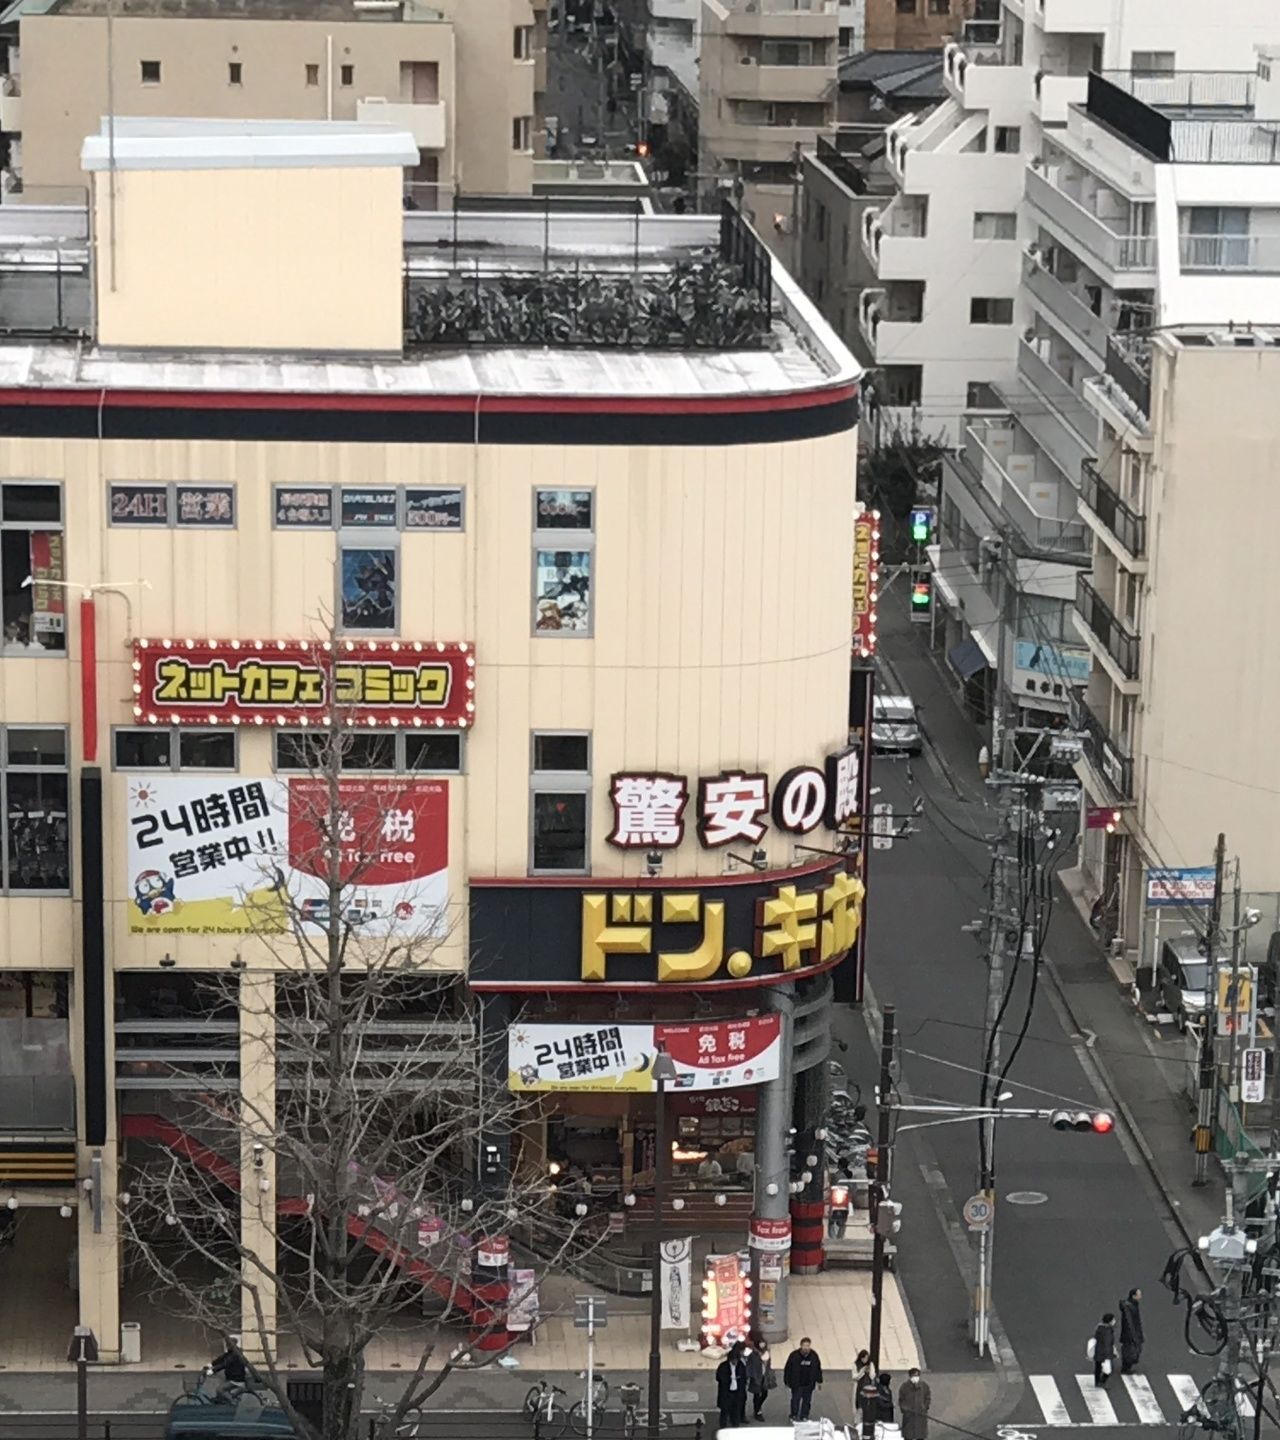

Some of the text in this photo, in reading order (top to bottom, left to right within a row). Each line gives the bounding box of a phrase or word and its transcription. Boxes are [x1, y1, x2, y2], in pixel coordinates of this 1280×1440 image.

[112, 493, 167, 517] 24H
[158, 663, 446, 702] ネットカフェ コミック
[131, 782, 270, 849] 24時間
[613, 750, 860, 845] 驚安の殿
[534, 1027, 623, 1066] 24時間
